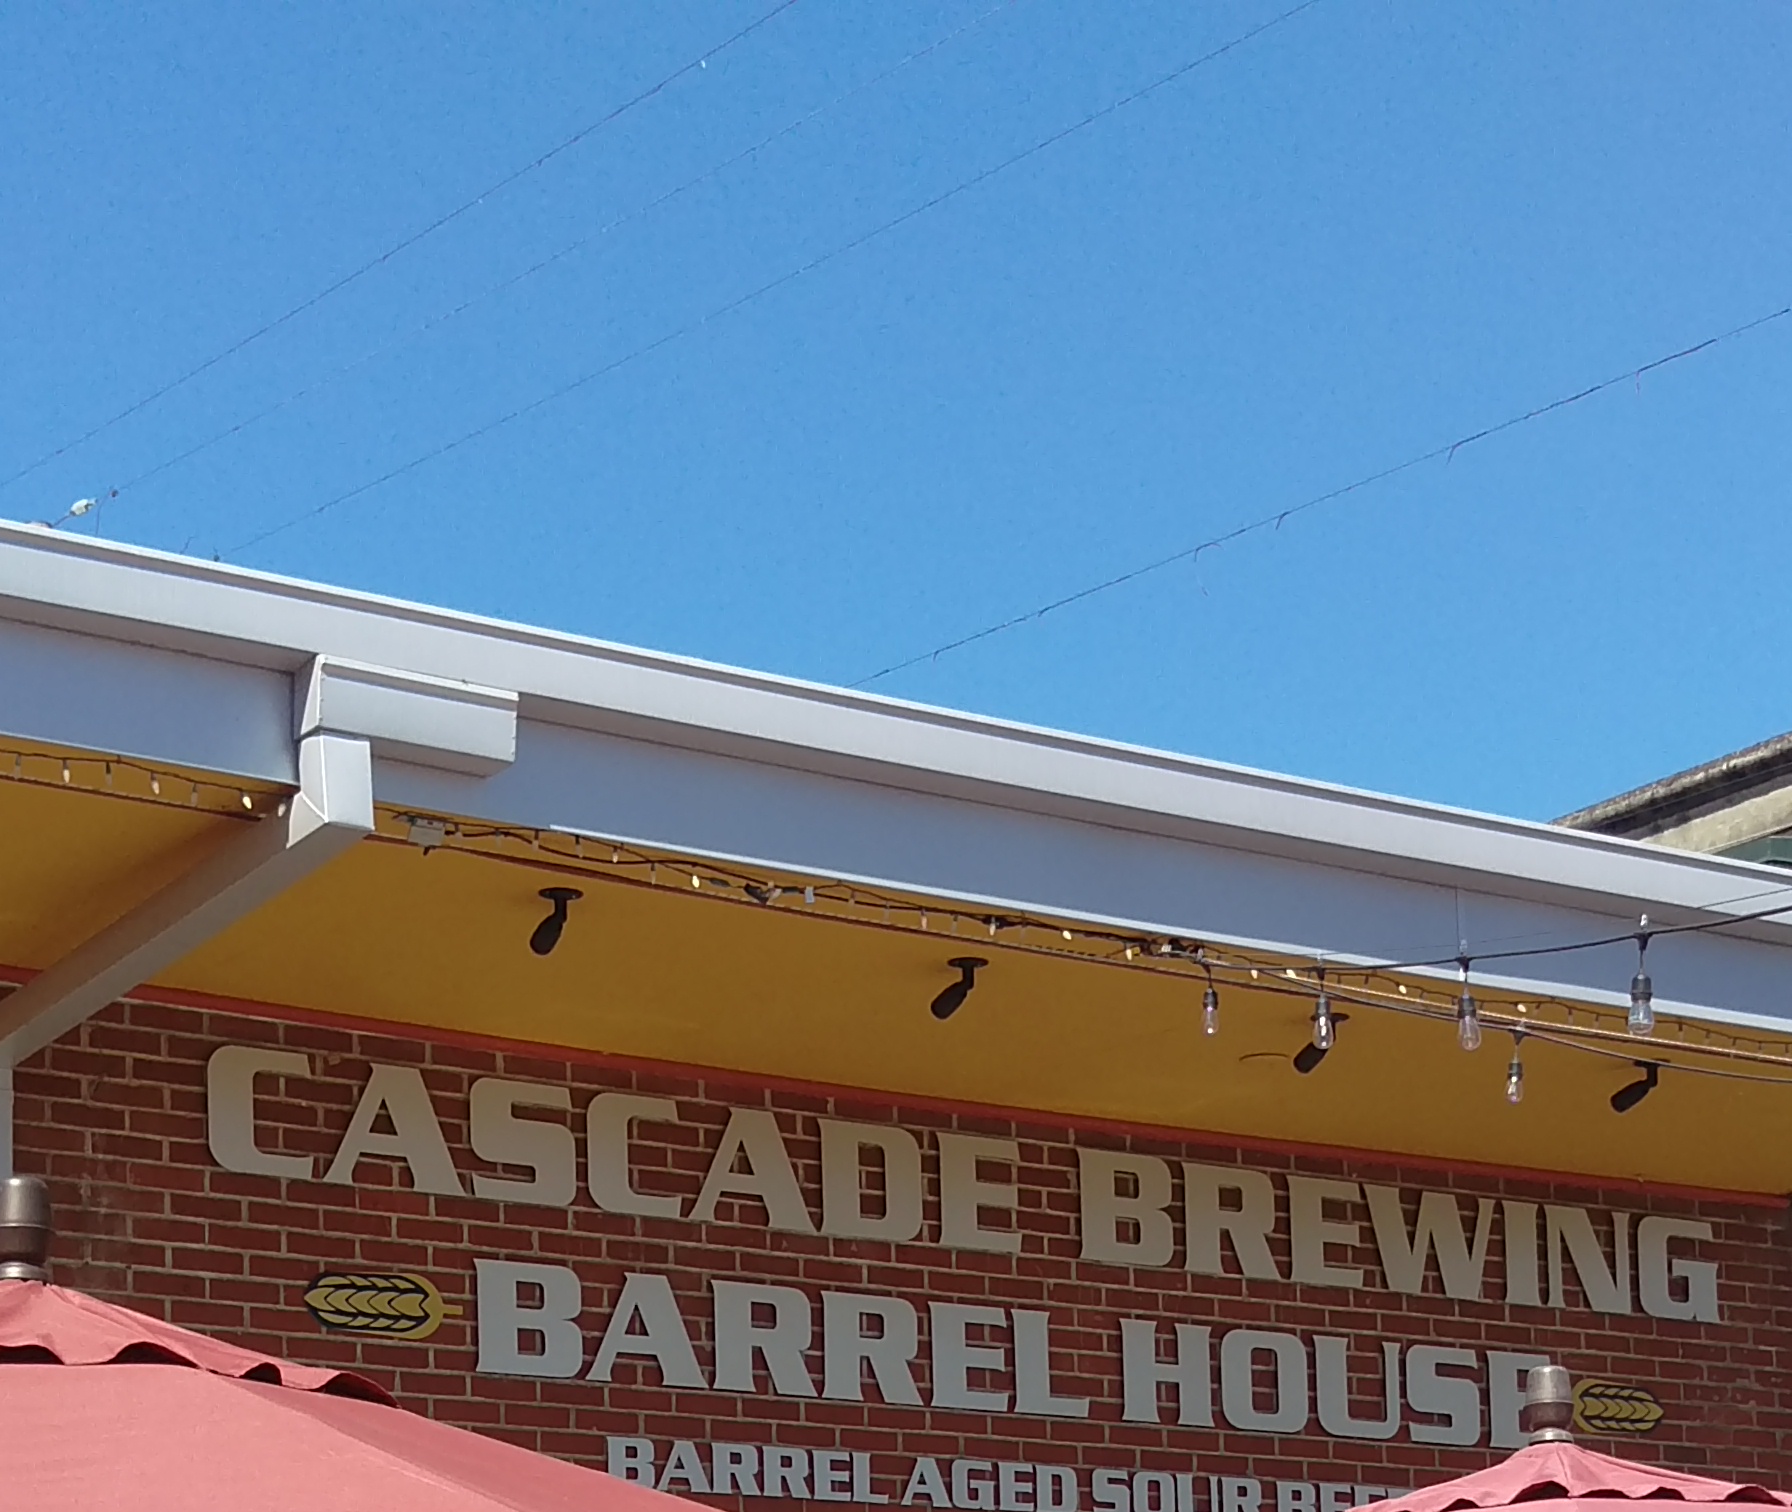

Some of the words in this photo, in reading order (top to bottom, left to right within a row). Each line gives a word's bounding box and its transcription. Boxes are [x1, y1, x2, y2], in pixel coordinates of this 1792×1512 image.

[208, 1044, 1023, 1256] CASCADE
[1076, 1146, 1721, 1324] BREWING
[473, 1257, 1091, 1418] BARREL
[608, 1436, 889, 1505] BARREL
